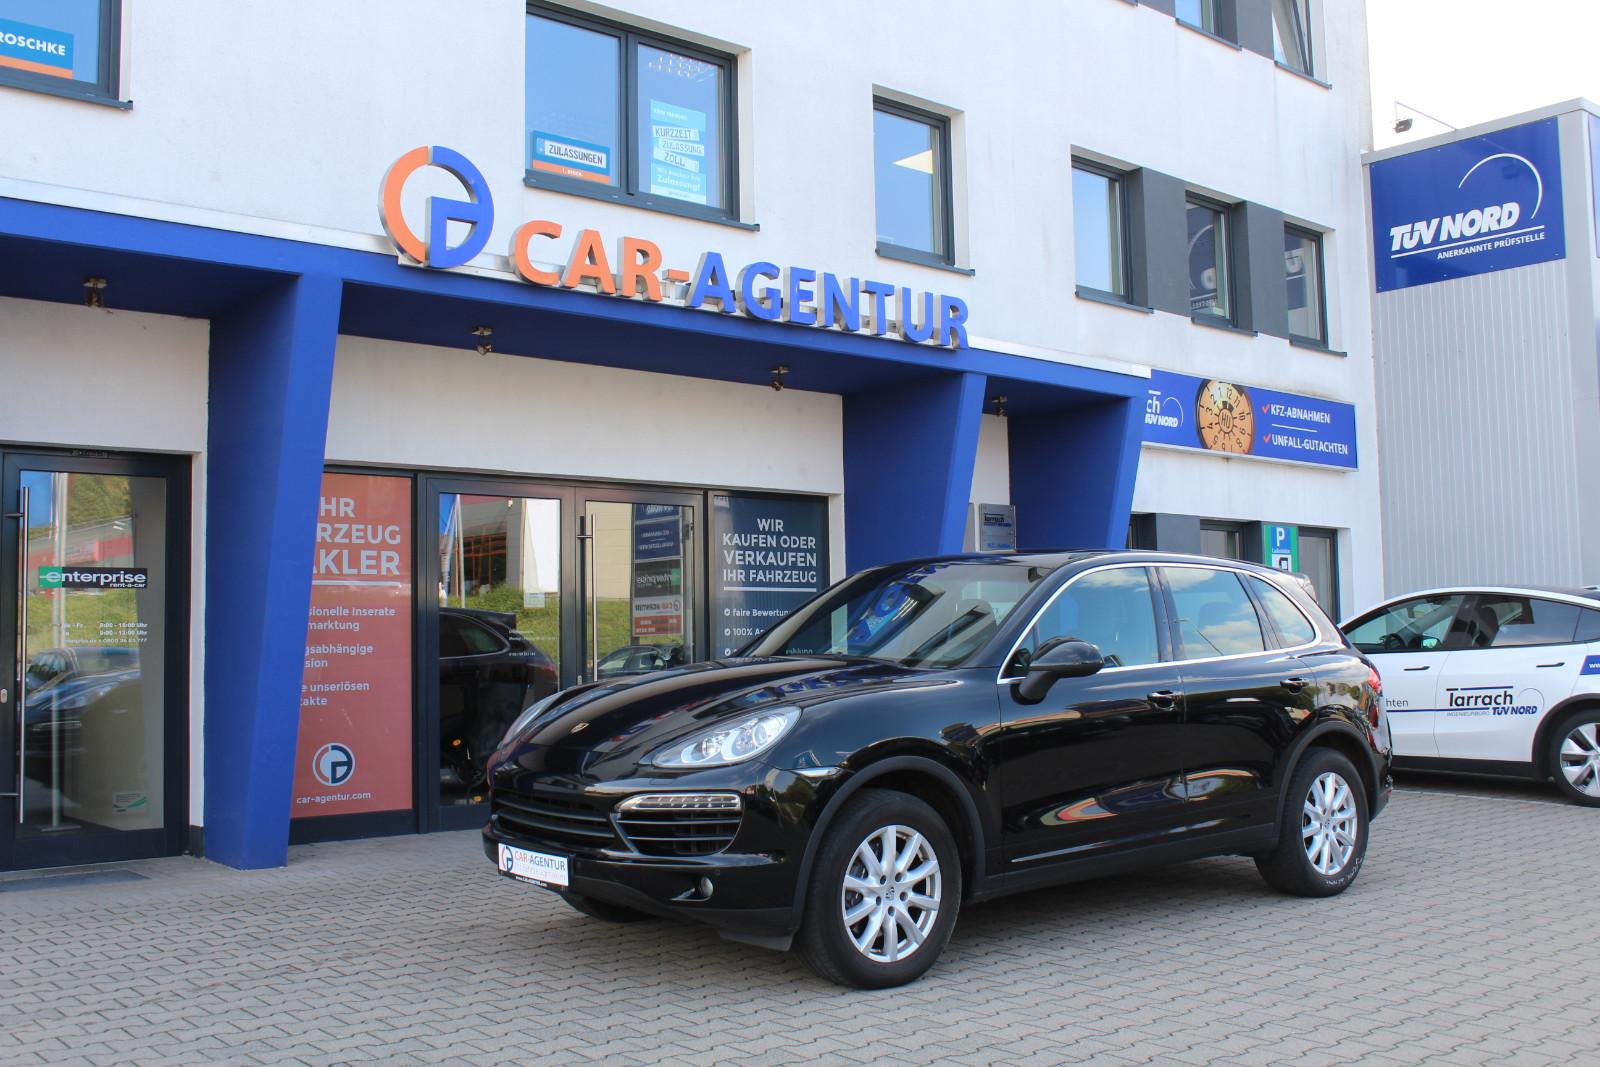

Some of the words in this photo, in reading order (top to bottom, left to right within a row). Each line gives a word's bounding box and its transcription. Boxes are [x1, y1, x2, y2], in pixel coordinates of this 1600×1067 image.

[549, 144, 603, 166] ZULASSUNGEN
[1390, 217, 1440, 252] TÜV
[1439, 201, 1521, 242] NORD
[1437, 242, 1493, 260] ANERKANNTE
[1494, 231, 1545, 249] PRÜFSTELLE
[508, 219, 969, 350] CAR-AGENTUR
[1158, 415, 1179, 428] NORD
[1270, 404, 1331, 425] KFZ-ABNAHMEN
[1272, 434, 1349, 456] UNFALL-GUTACHTEN
[320, 496, 356, 518] HR
[316, 522, 401, 545] RZEUG
[757, 518, 784, 533] WIR
[722, 533, 777, 548] KAUFEN
[780, 535, 816, 549] ODER
[1276, 527, 1285, 547] P
[313, 549, 401, 575] KLER
[723, 549, 817, 568] VERKAUFEN
[45, 570, 147, 586] enterprise
[723, 568, 746, 582] IHR
[749, 570, 817, 584] FAHRZEUG
[352, 606, 396, 617] Inserate
[732, 608, 751, 617] faire
[752, 608, 791, 617] Bewertun
[732, 627, 753, 636] 100%
[310, 680, 370, 692] unseriösen
[1385, 697, 1409, 708] hten
[1492, 706, 1510, 716] TÜV
[1510, 705, 1538, 715] NORD
[296, 791, 371, 805] car-agentur.com
